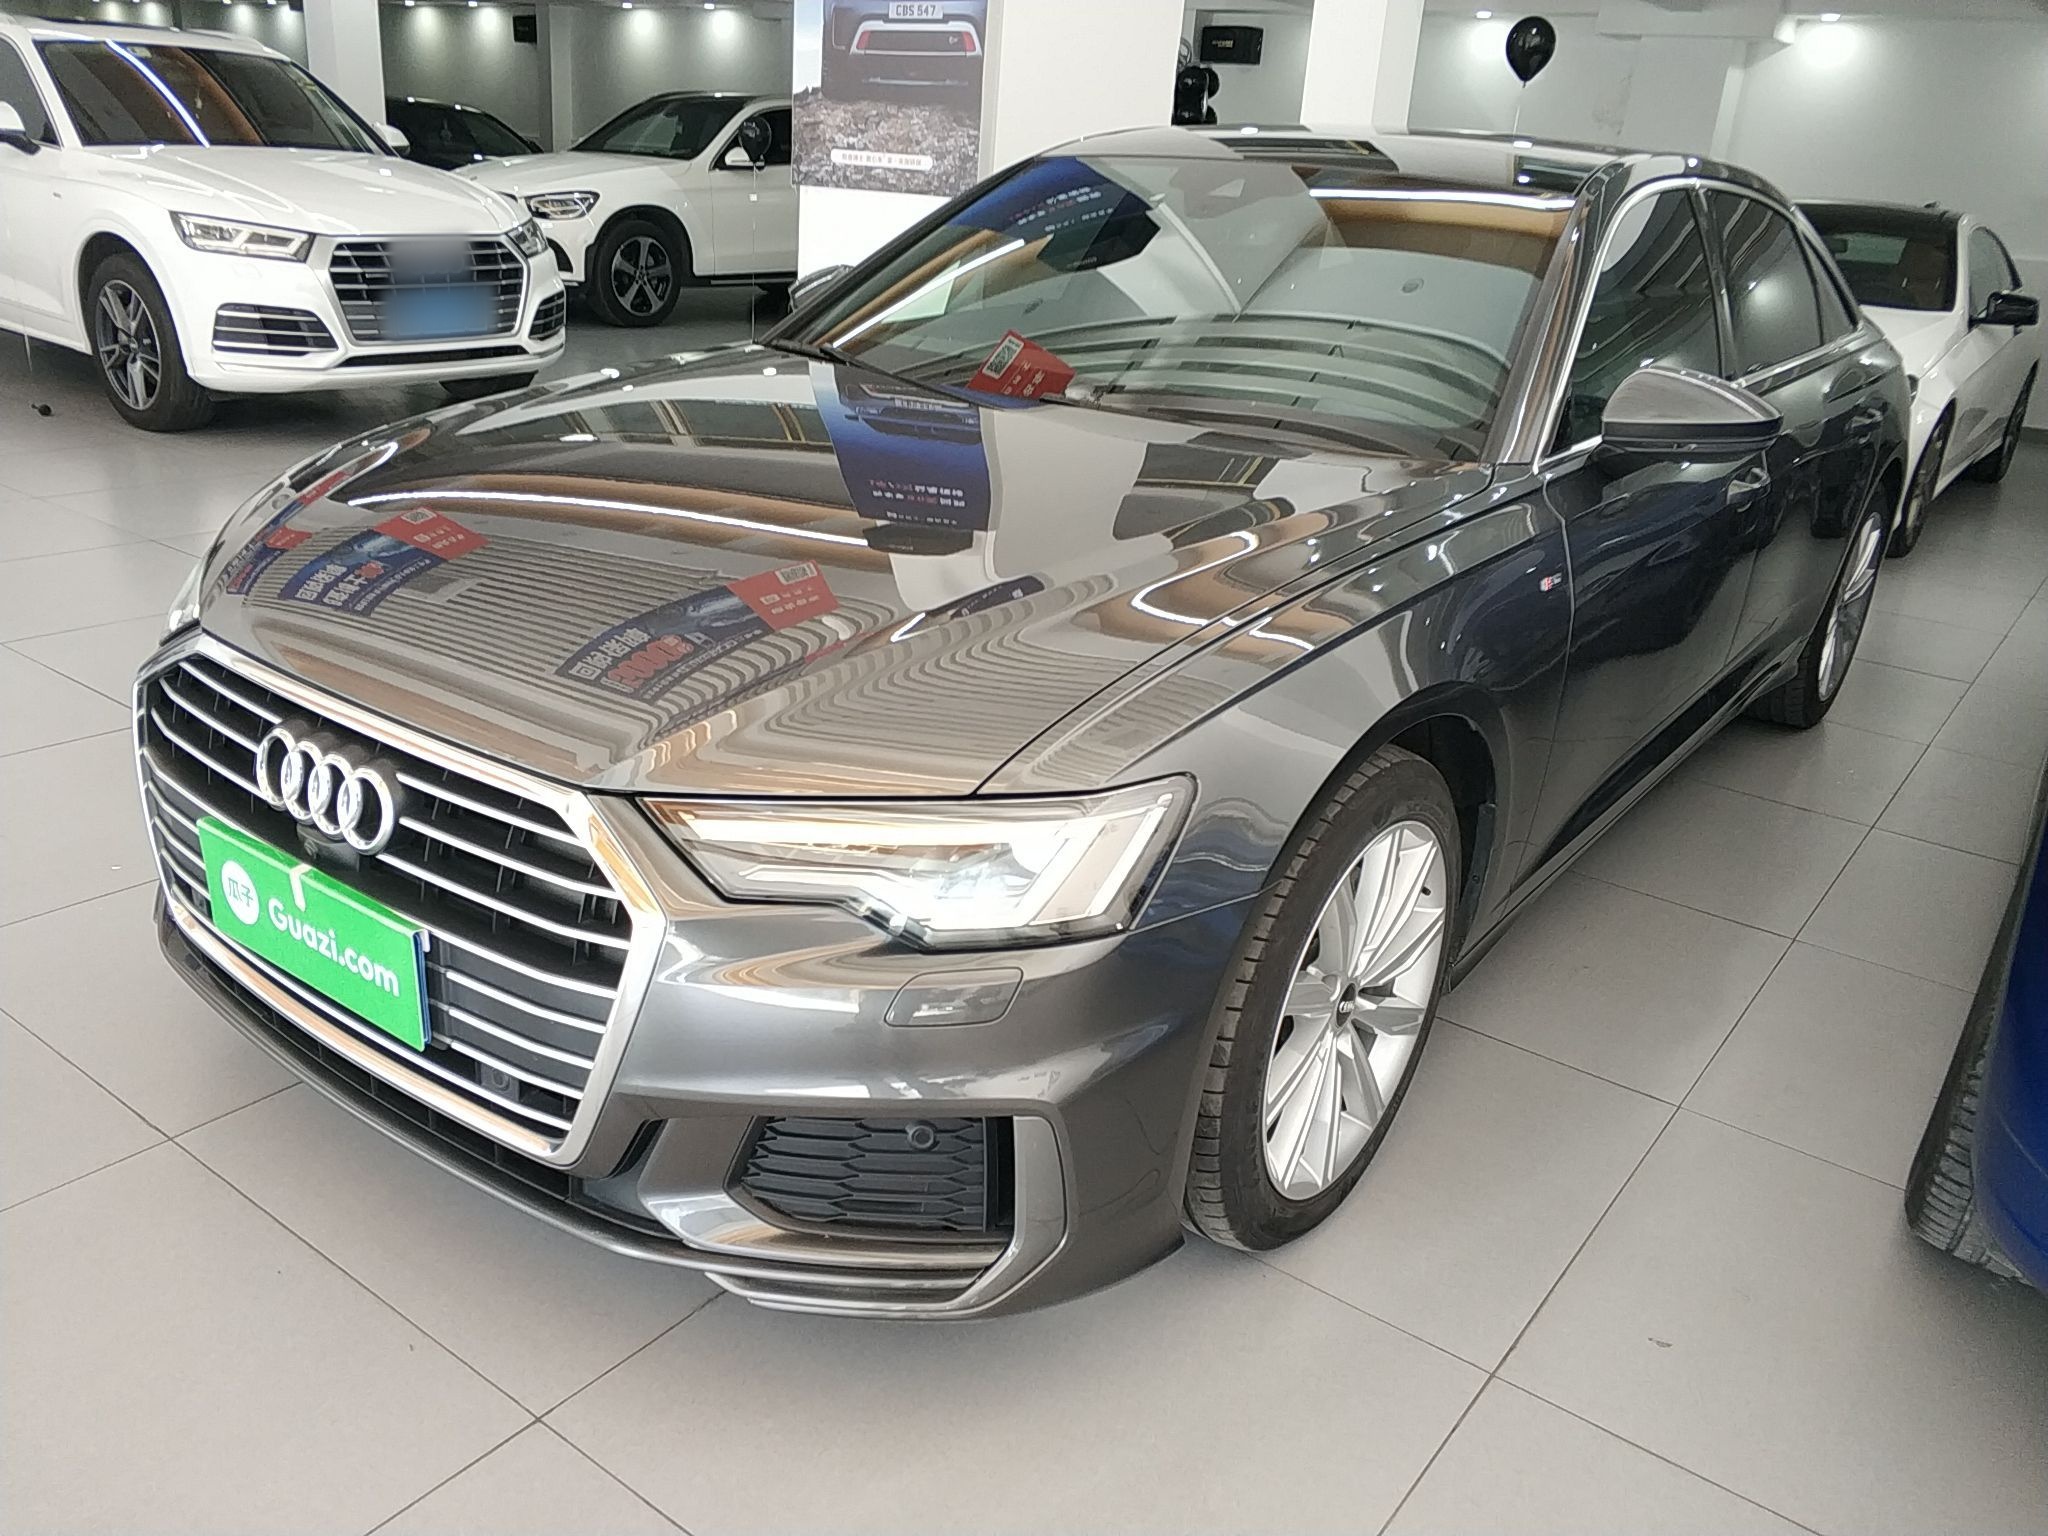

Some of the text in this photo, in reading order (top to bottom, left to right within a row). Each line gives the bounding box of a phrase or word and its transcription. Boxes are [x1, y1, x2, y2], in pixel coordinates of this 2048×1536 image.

[895, 4, 937, 17] CBS 547
[228, 876, 254, 908] 瓜子
[268, 897, 400, 998] Guazi.com
